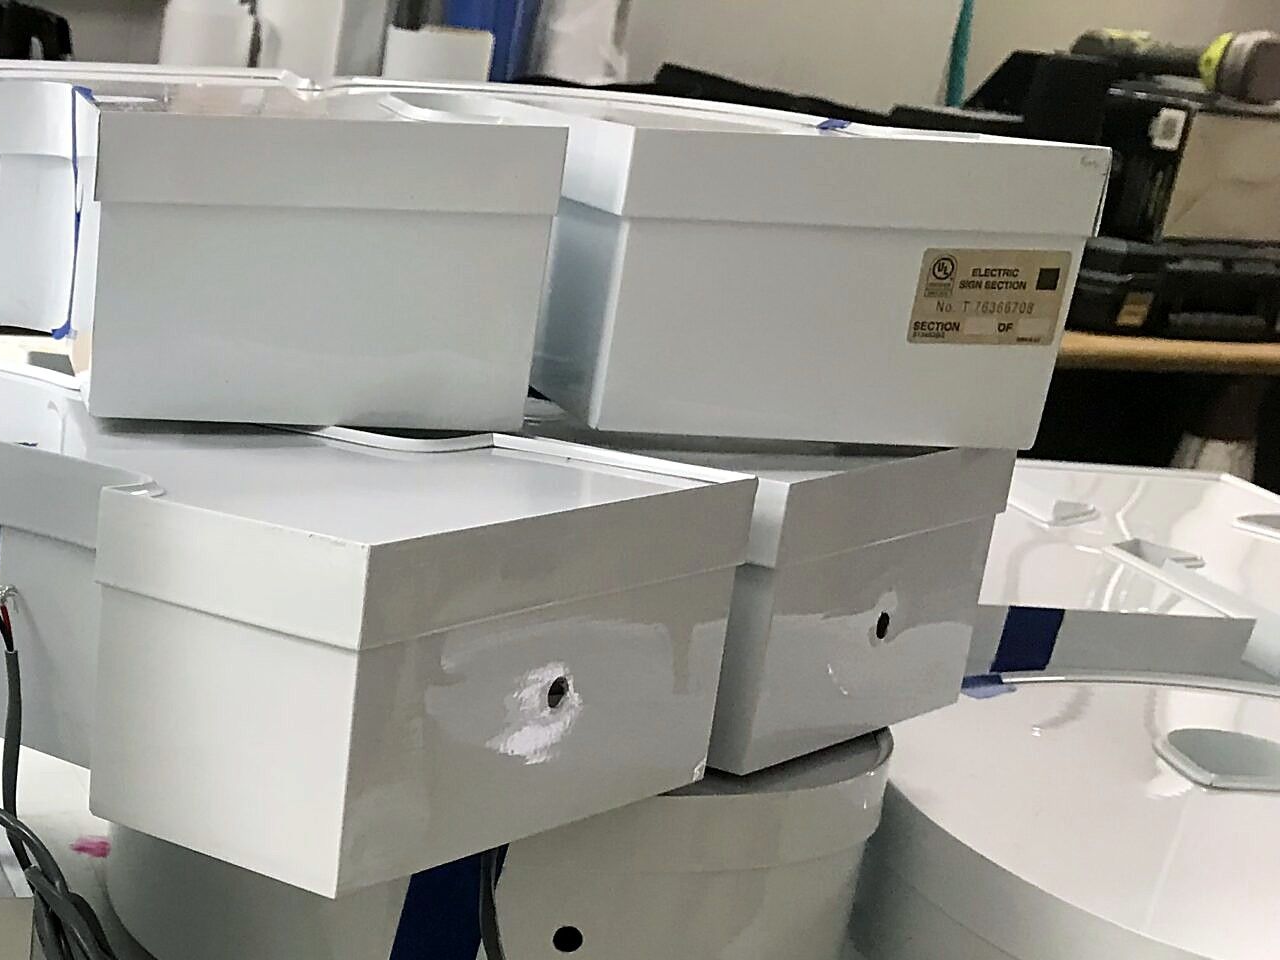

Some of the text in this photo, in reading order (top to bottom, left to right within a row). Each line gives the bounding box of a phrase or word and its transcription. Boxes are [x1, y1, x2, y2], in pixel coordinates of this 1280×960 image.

[971, 268, 1020, 278] ELECTRIC
[959, 280, 983, 290] SIGN
[985, 281, 1027, 291] SECTION
[963, 301, 971, 313] T
[913, 321, 1014, 332] SECTION OF
